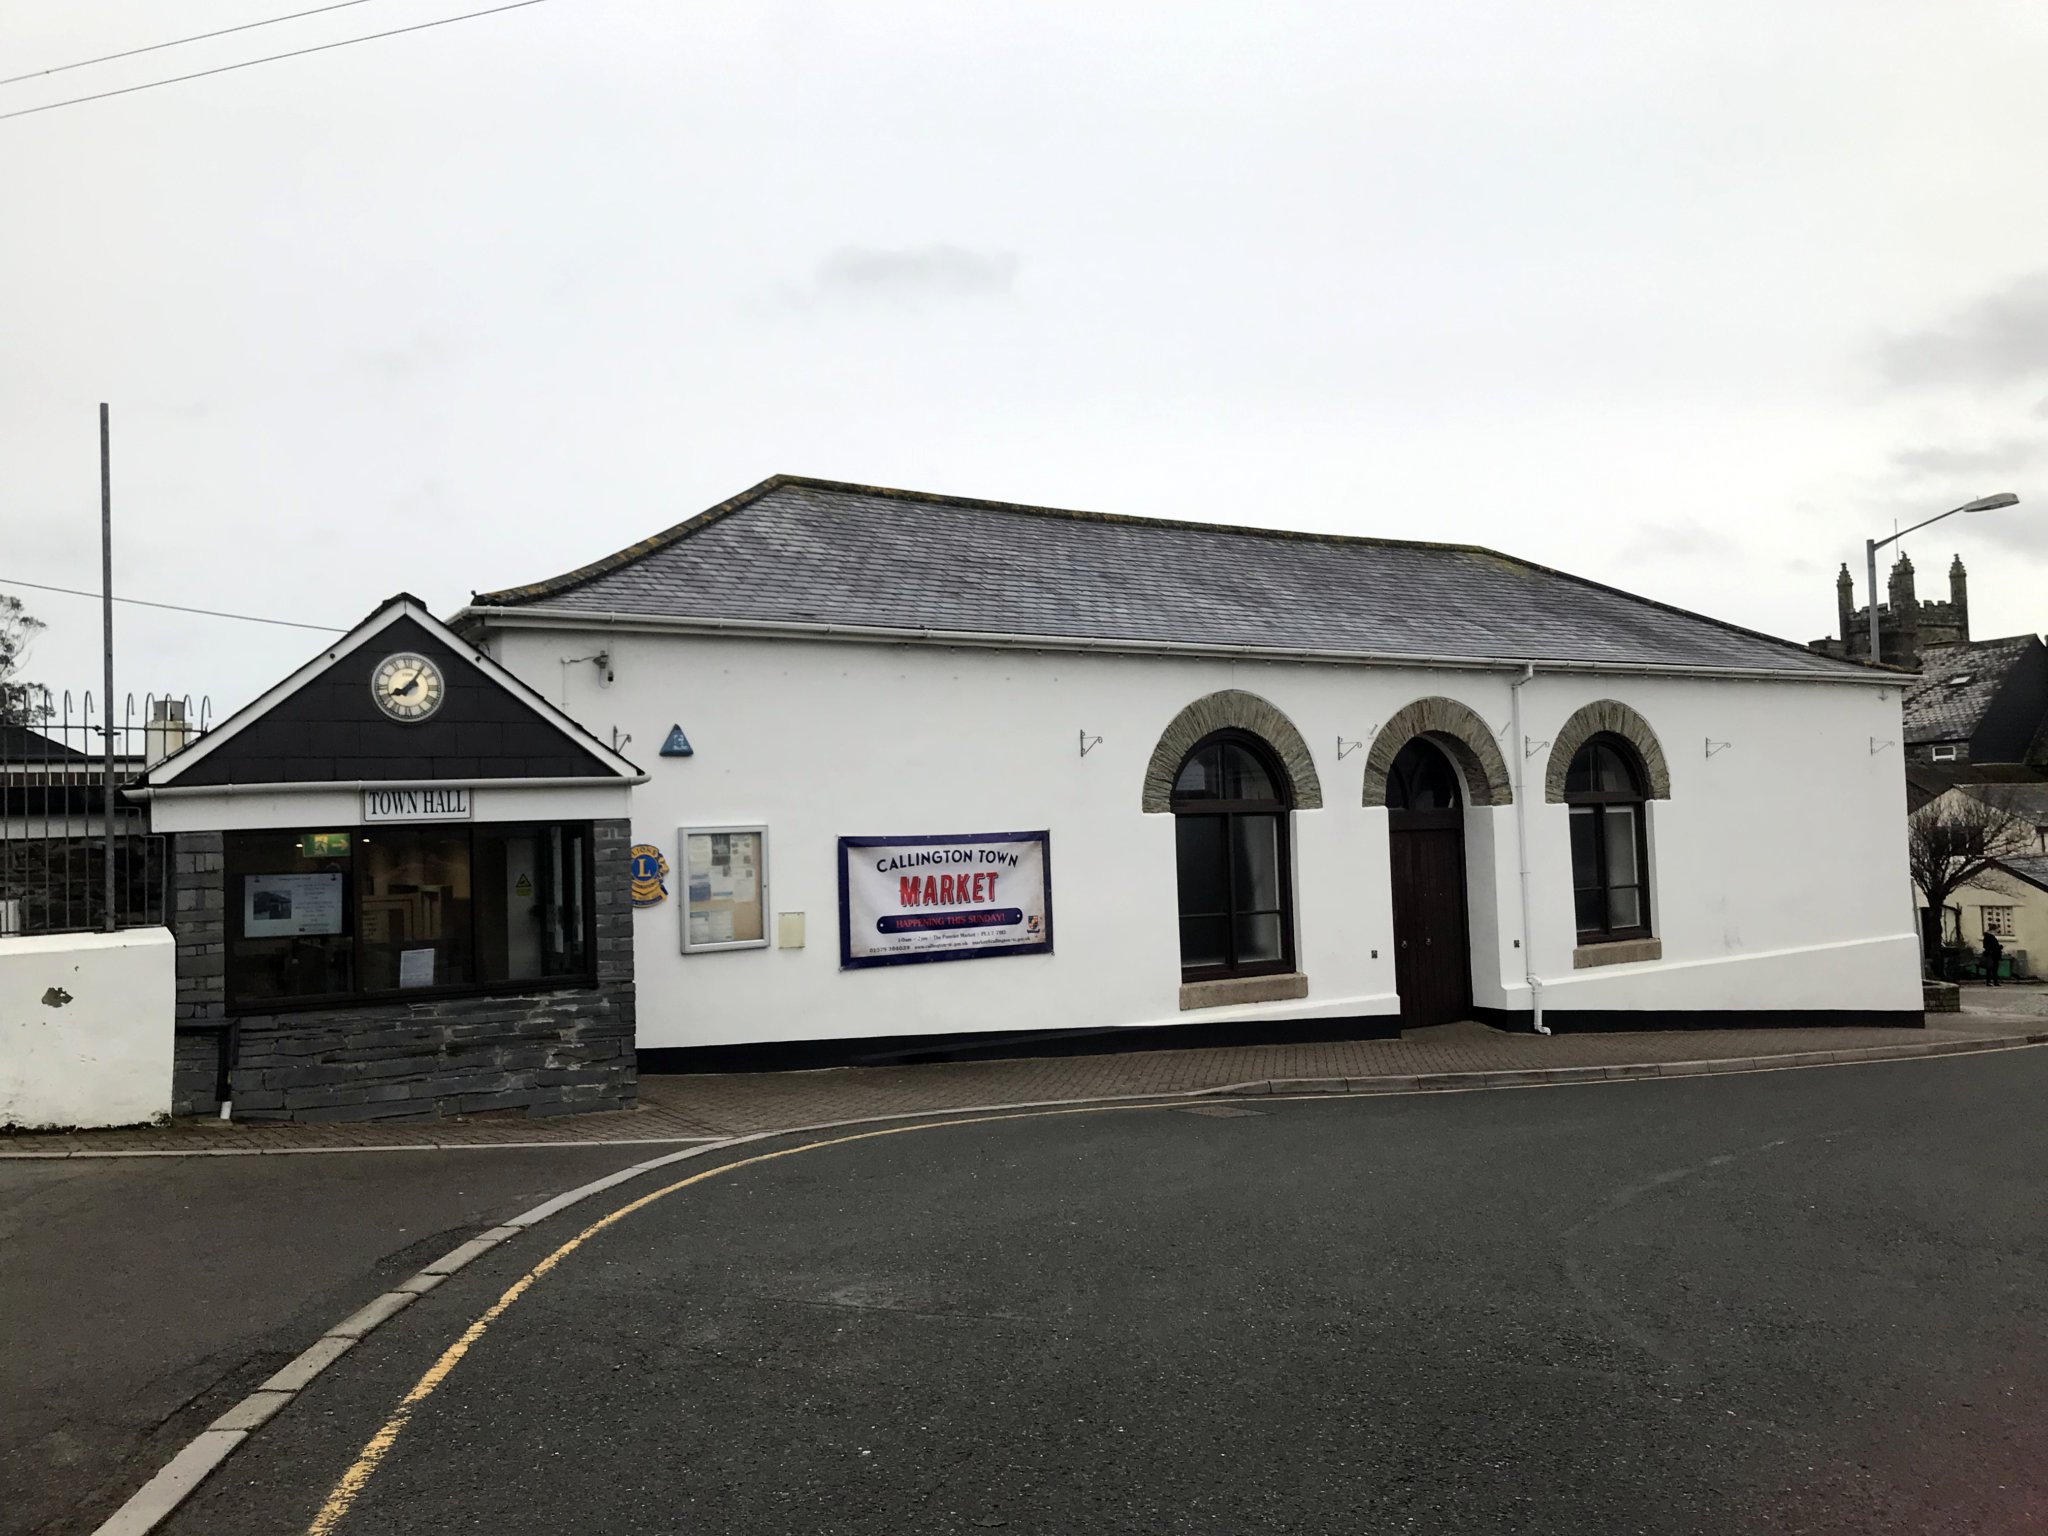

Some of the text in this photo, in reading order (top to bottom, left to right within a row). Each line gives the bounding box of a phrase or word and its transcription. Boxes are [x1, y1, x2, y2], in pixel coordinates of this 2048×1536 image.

[368, 790, 467, 815] TOWN HALL
[638, 859, 651, 877] L
[876, 850, 1019, 873] CALLINGTON TOWN
[900, 872, 998, 907] MARKET
[896, 913, 1006, 928] HAPPENING THIS SUNDAY!
